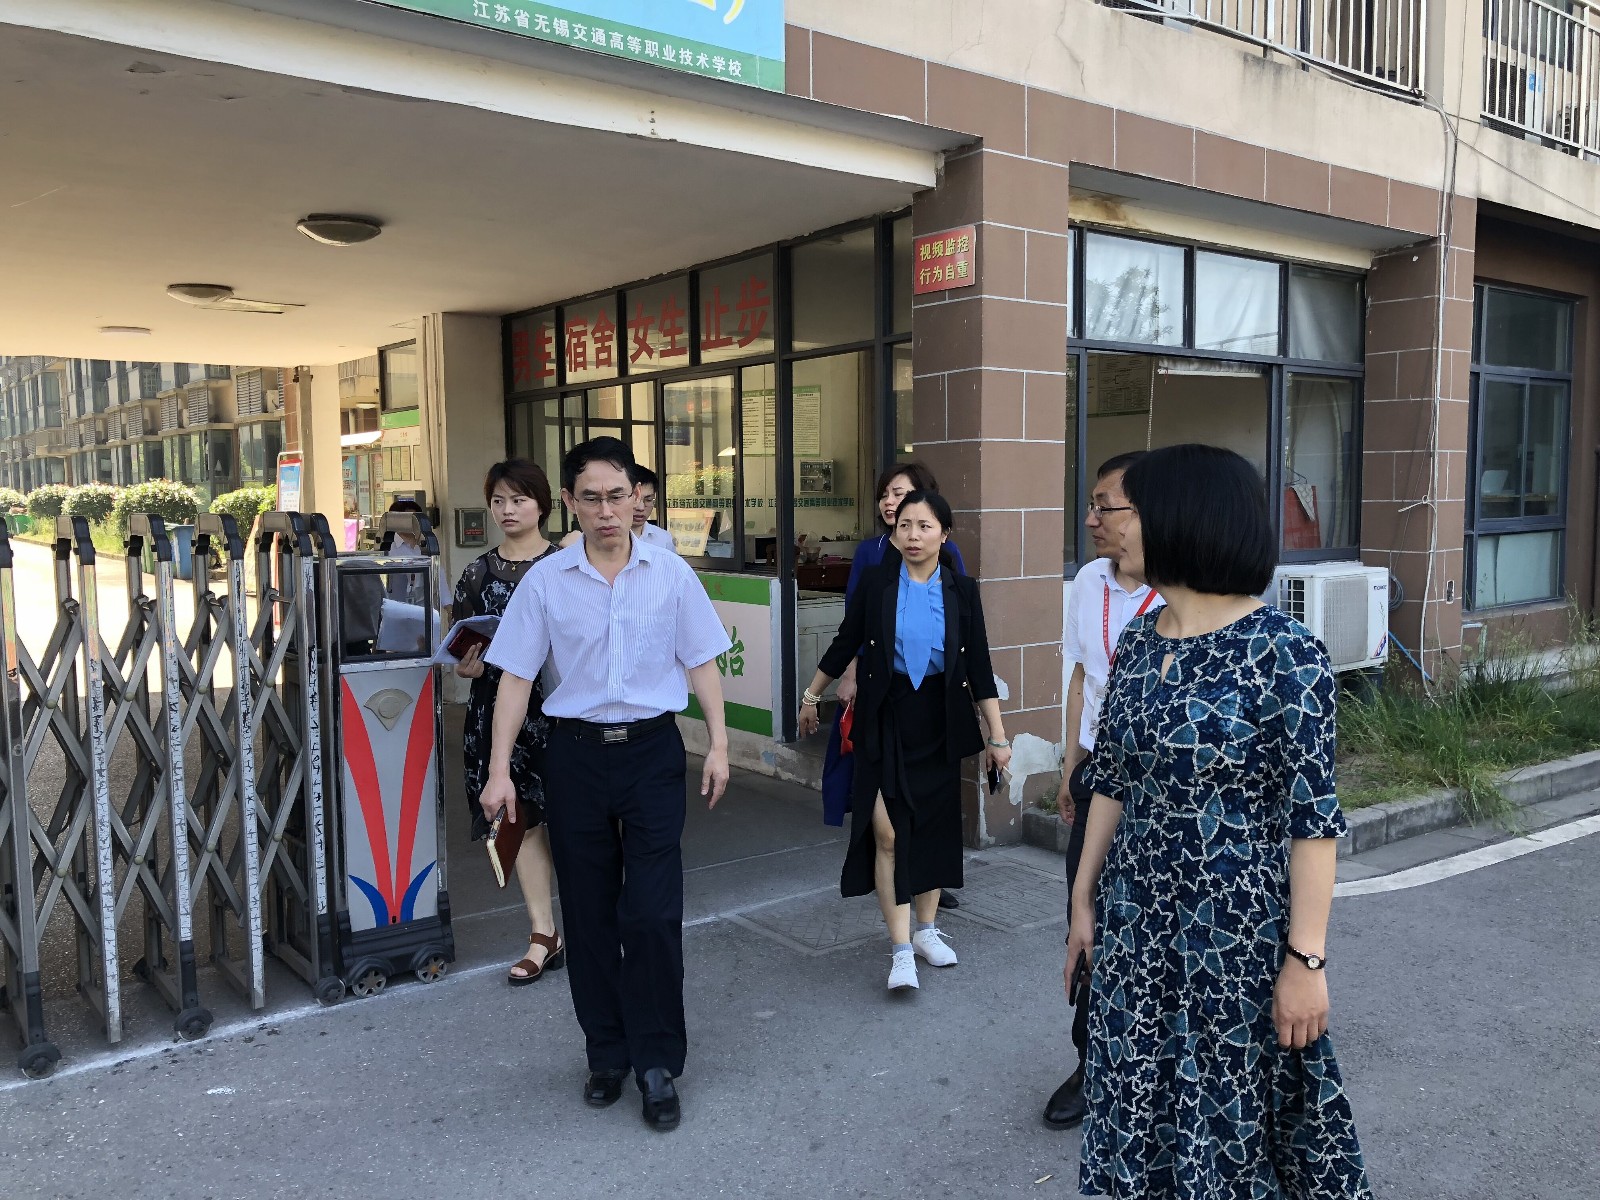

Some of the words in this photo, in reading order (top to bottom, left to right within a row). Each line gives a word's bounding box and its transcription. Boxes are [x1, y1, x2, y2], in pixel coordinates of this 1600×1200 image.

[473, 0, 742, 77] 江苏省无锡交通高等职业技术学校
[920, 235, 969, 261] 视频监控
[920, 261, 969, 285] 行为自重
[512, 275, 771, 384] 男生宿舍女生止步
